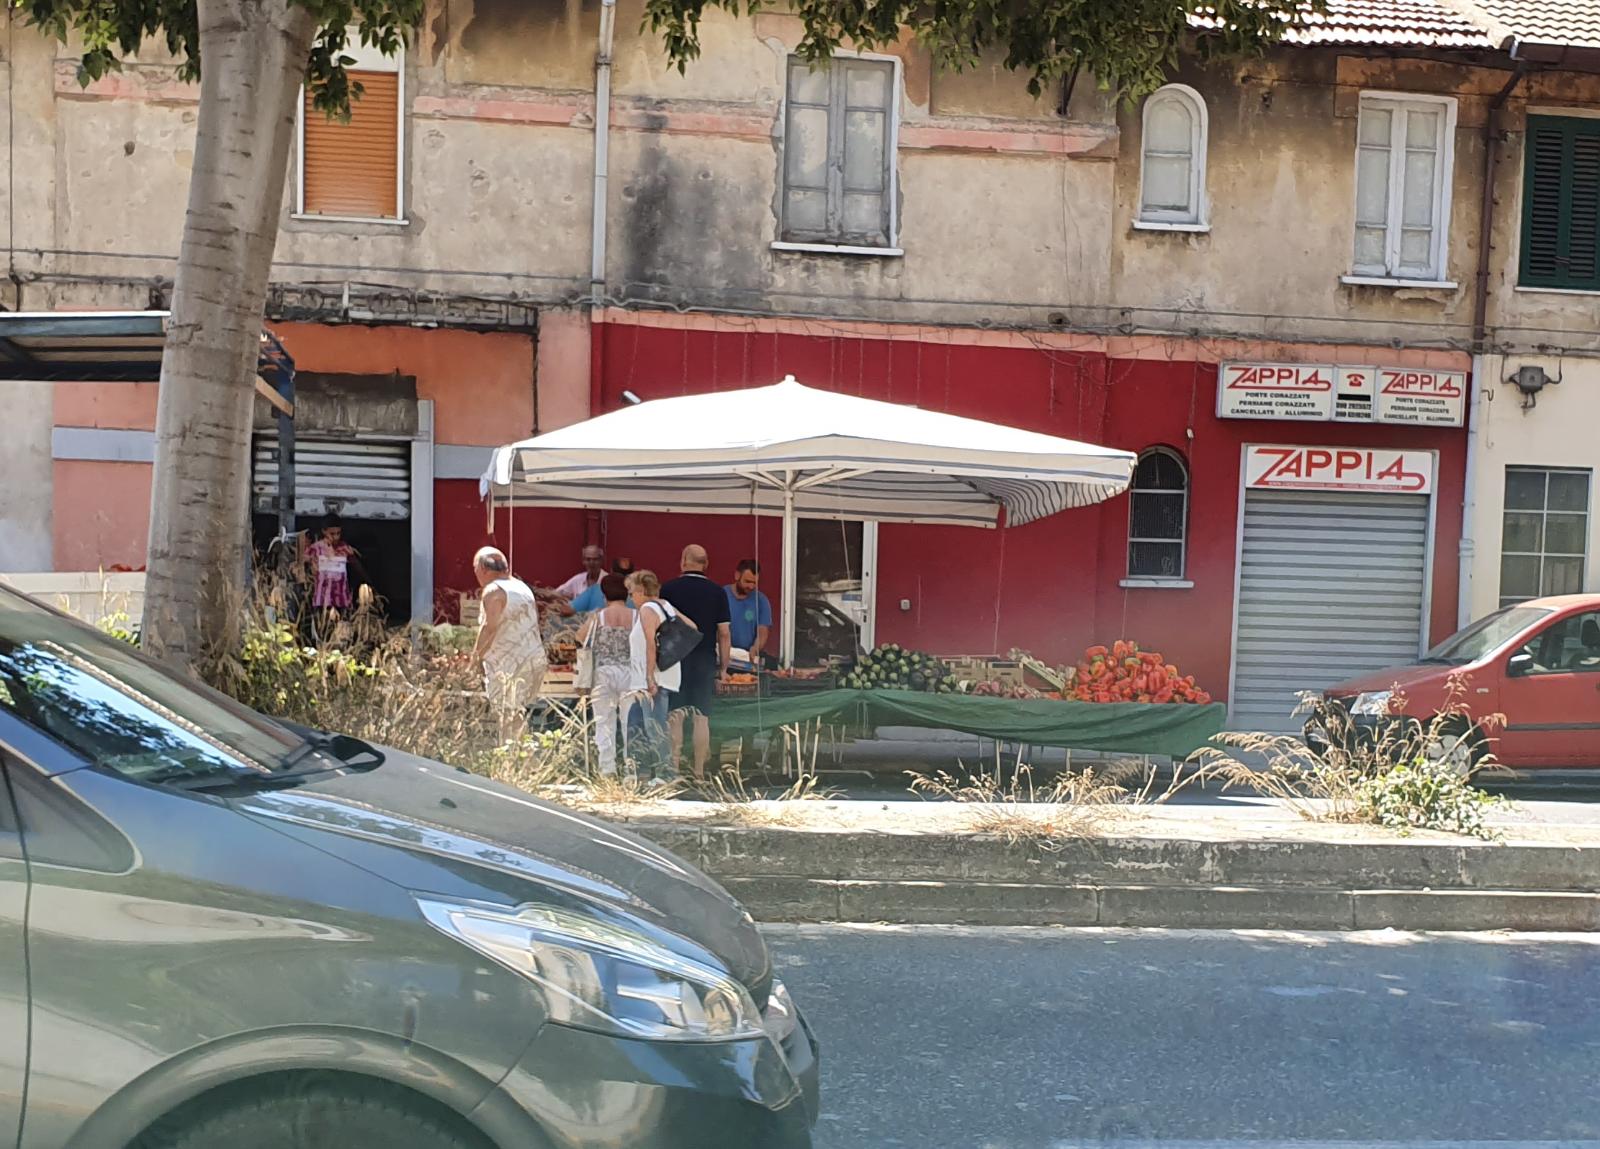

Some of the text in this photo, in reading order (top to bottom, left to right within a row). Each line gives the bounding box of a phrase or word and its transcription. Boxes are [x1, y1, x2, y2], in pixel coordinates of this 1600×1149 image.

[1227, 366, 1332, 392] ZAPPIA
[1381, 371, 1461, 398] ZAPPIA
[1252, 447, 1426, 491] ZAPPIA
